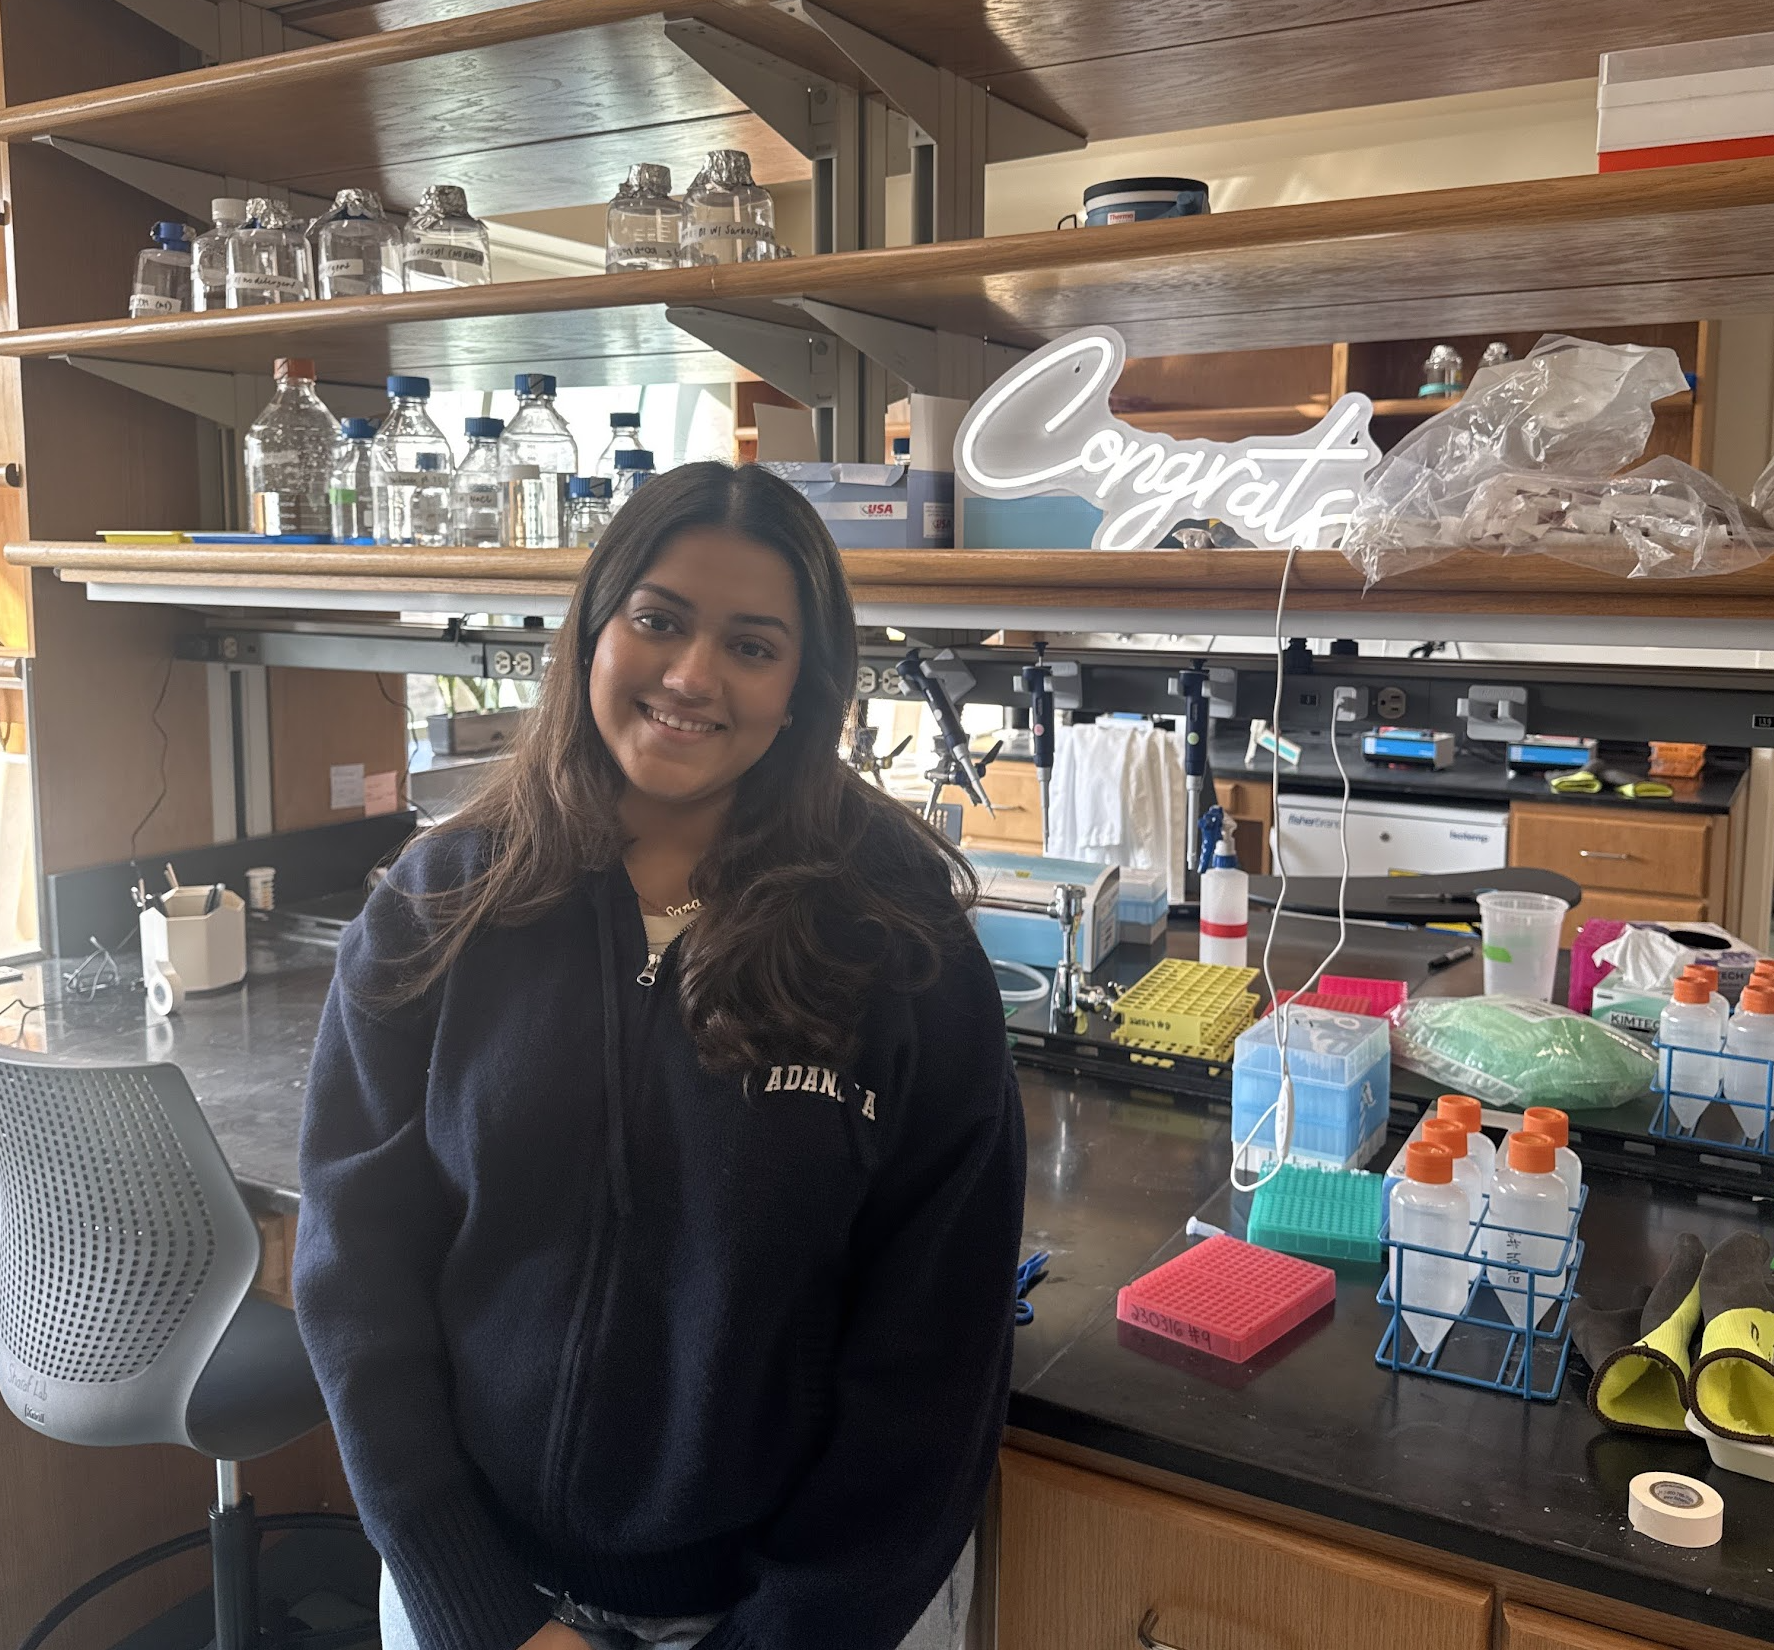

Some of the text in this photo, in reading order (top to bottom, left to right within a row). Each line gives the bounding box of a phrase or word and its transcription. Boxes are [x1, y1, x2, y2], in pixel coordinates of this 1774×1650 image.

[962, 336, 1368, 549] Congrats
[868, 504, 893, 514] USA
[1610, 1013, 1660, 1032] KIMTEC
[763, 1064, 876, 1121] ADANA
[1131, 1303, 1212, 1351] 230316 #9
[33, 1379, 48, 1402] Lab
